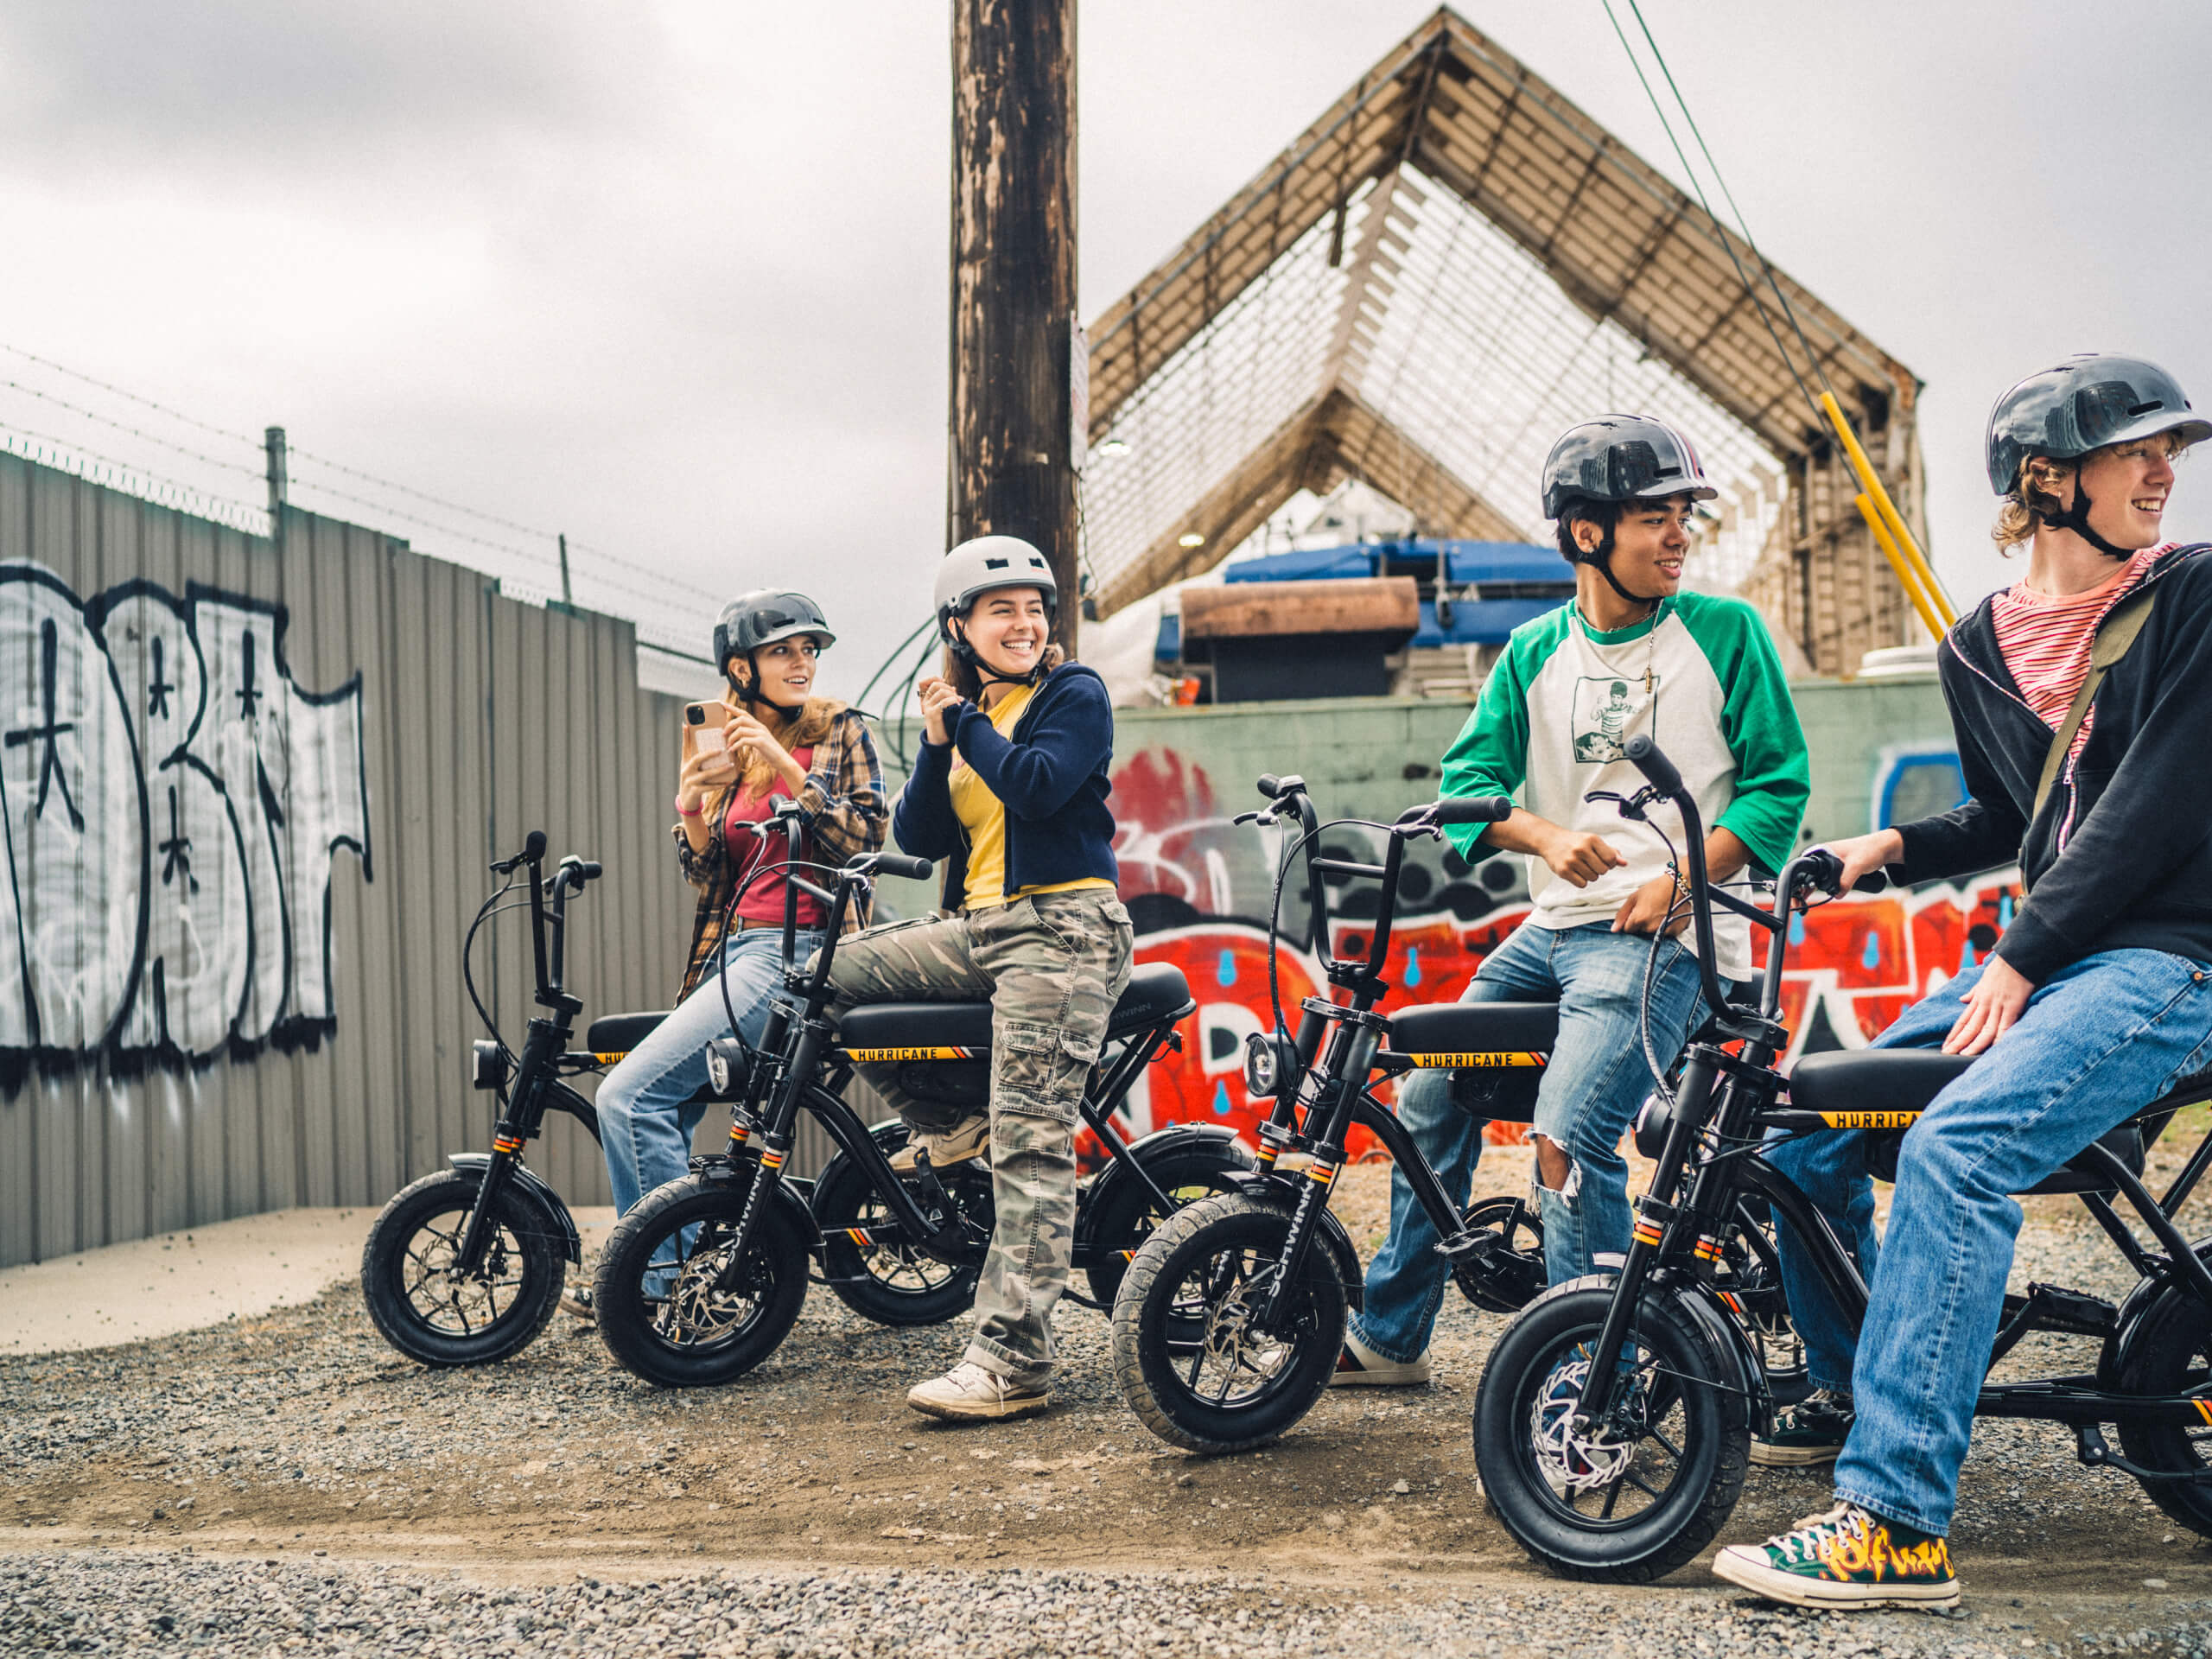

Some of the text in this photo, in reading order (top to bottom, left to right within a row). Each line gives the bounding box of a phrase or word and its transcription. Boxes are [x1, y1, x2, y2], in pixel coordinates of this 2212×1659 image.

[858, 1048, 938, 1061] HURRICANE
[1423, 1053, 1513, 1067] HURRICANE
[1836, 1112, 1918, 1128] HURRICA
[1268, 1178, 1315, 1298] SCHWINN
